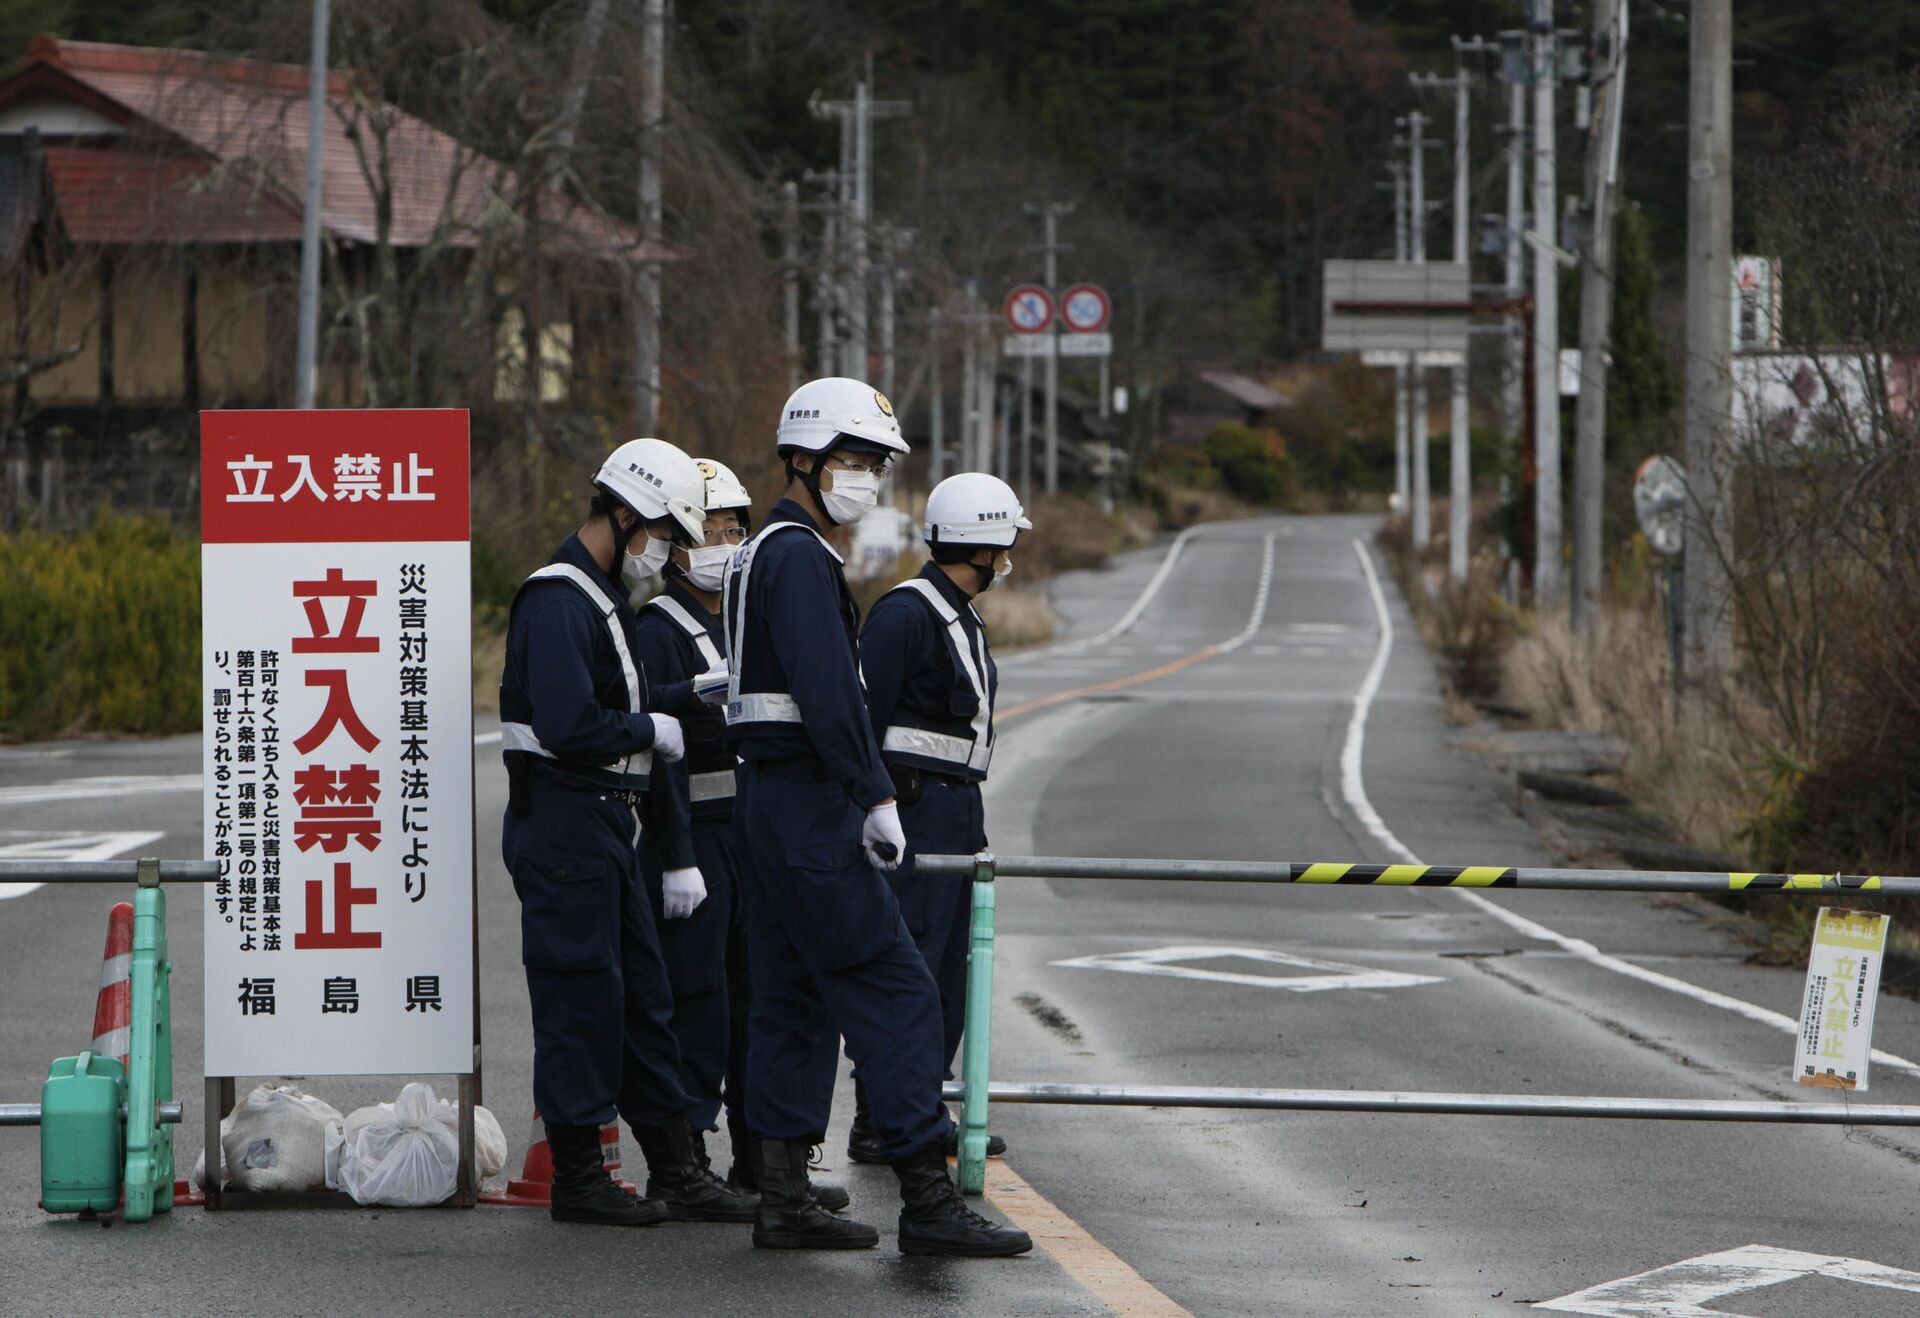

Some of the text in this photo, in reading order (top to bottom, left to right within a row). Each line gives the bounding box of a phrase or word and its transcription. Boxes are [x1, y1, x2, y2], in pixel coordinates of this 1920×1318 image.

[226, 453, 436, 502] 立入禁止
[237, 650, 257, 951] 第百十六条第一項第二号の規定によ
[260, 650, 281, 951] 許可なく立ち入ると災害対策基本法
[292, 568, 382, 950] 立入禁止
[399, 564, 429, 903] 災害対策基本法により
[238, 976, 442, 1015] 福島県
[1821, 956, 1857, 1060] 立入禁止
